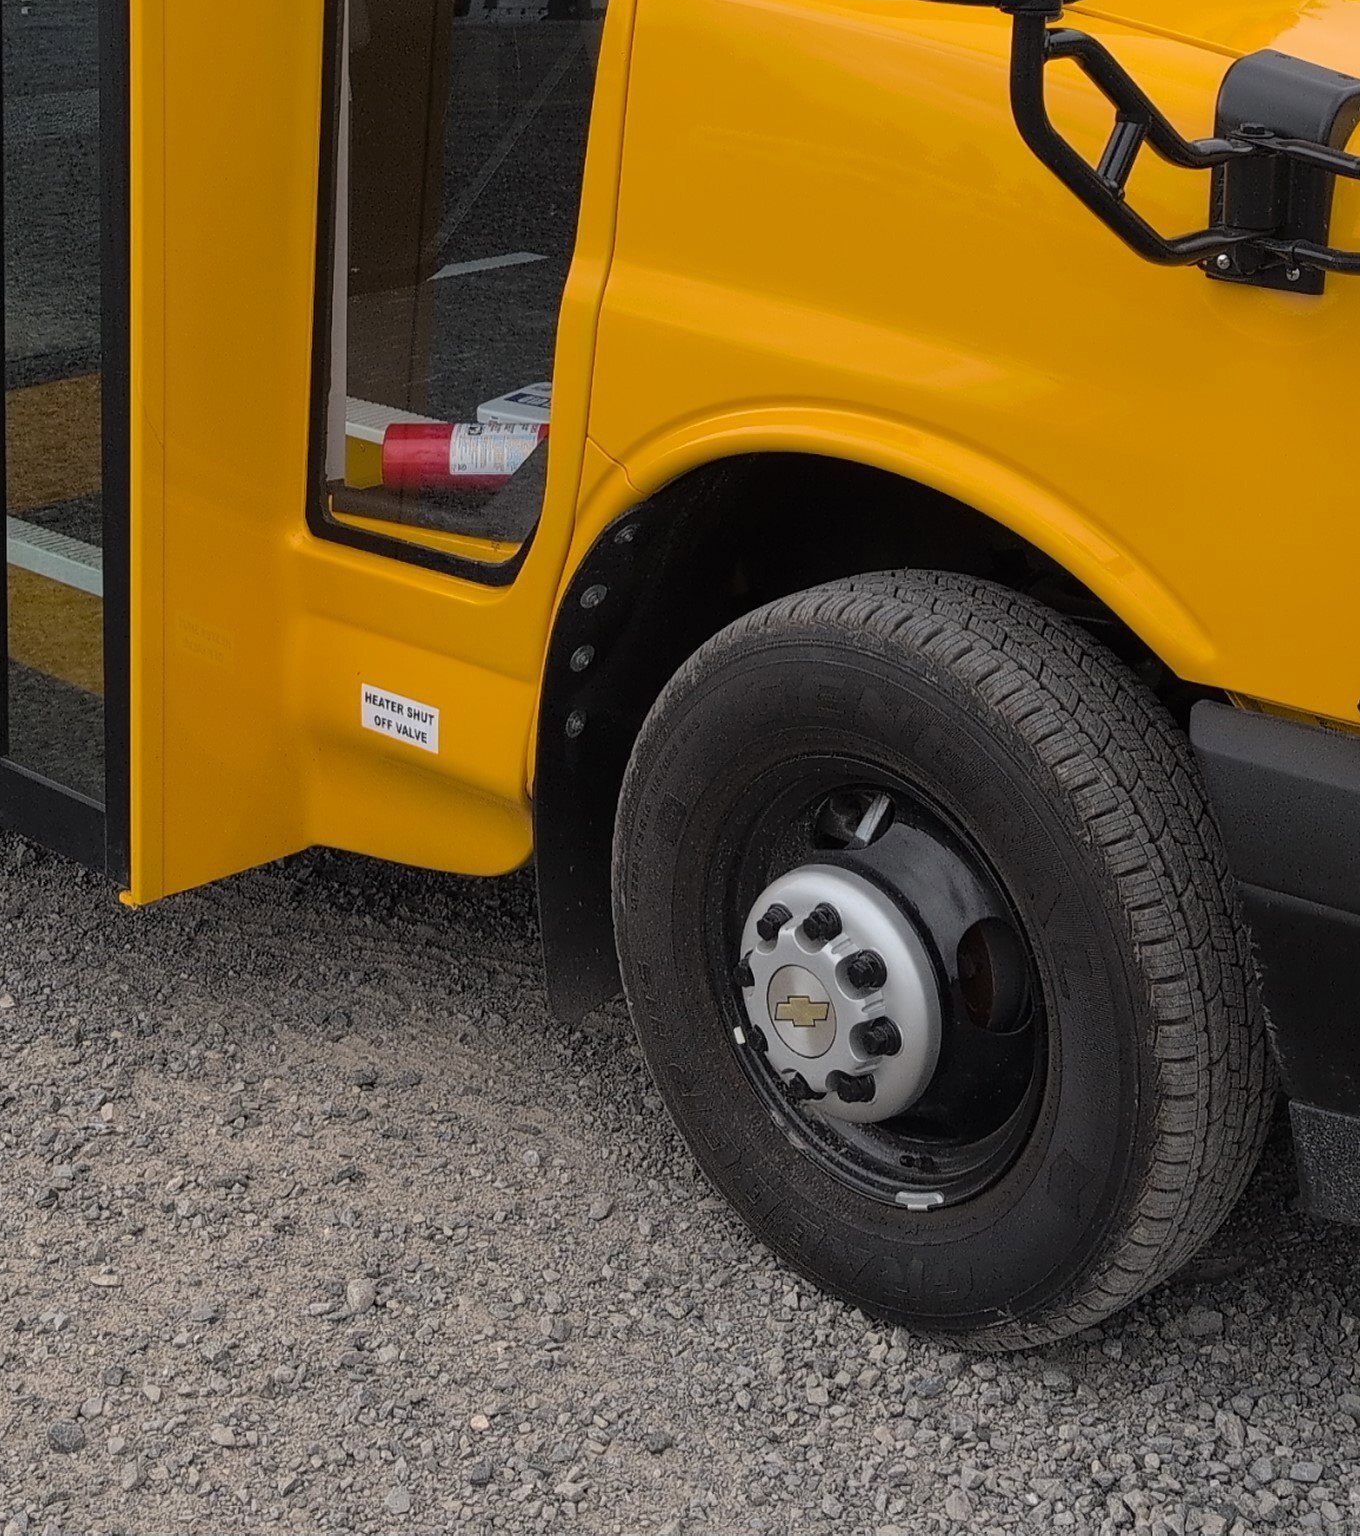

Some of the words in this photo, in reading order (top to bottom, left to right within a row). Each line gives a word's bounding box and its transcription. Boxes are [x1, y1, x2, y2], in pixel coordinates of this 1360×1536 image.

[364, 691, 403, 715] HEATER
[407, 706, 434, 725] SHUT
[374, 715, 392, 730] OFF
[396, 722, 427, 744] VALVE
